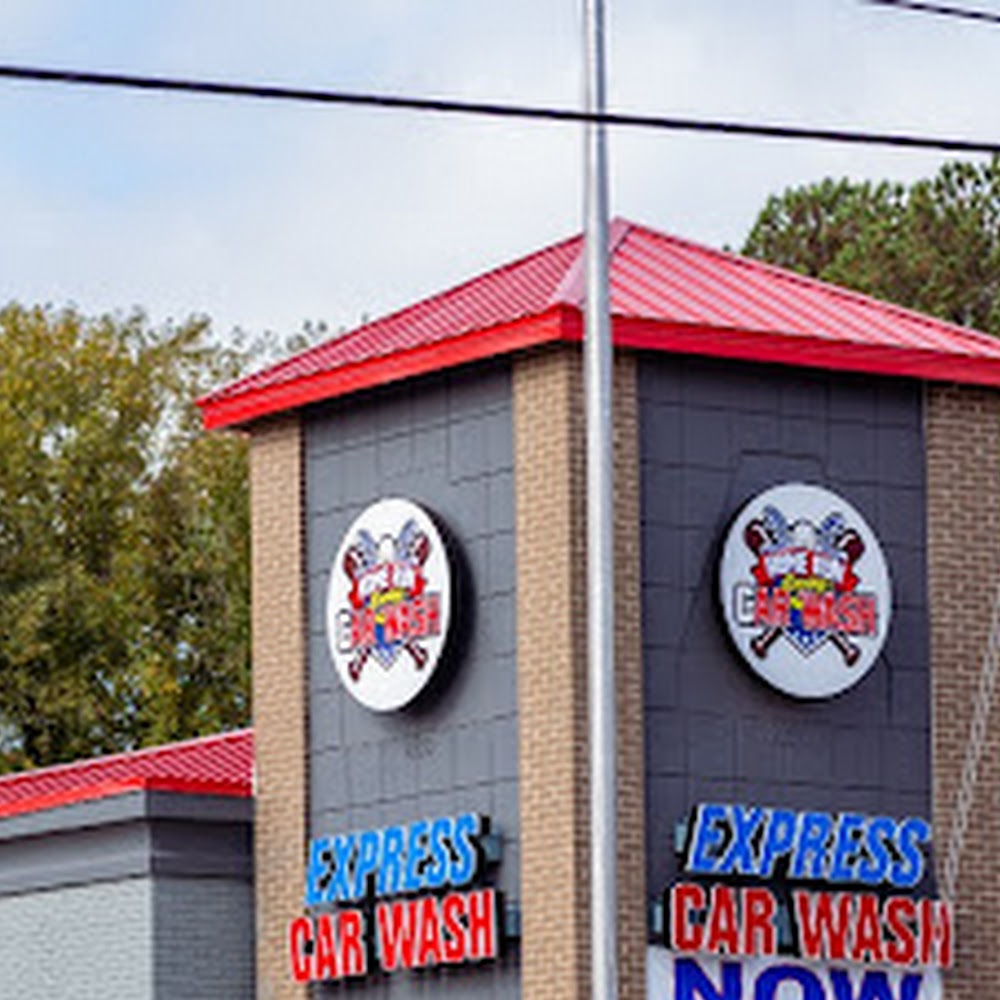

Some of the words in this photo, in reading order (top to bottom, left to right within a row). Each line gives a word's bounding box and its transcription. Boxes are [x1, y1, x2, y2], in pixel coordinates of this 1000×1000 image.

[304, 812, 478, 906] EXPRESS
[686, 803, 930, 887] EXPRESS
[287, 908, 367, 984] CAR
[376, 887, 495, 970] WASH
[671, 884, 778, 956] CAR
[794, 890, 952, 968] WASH
